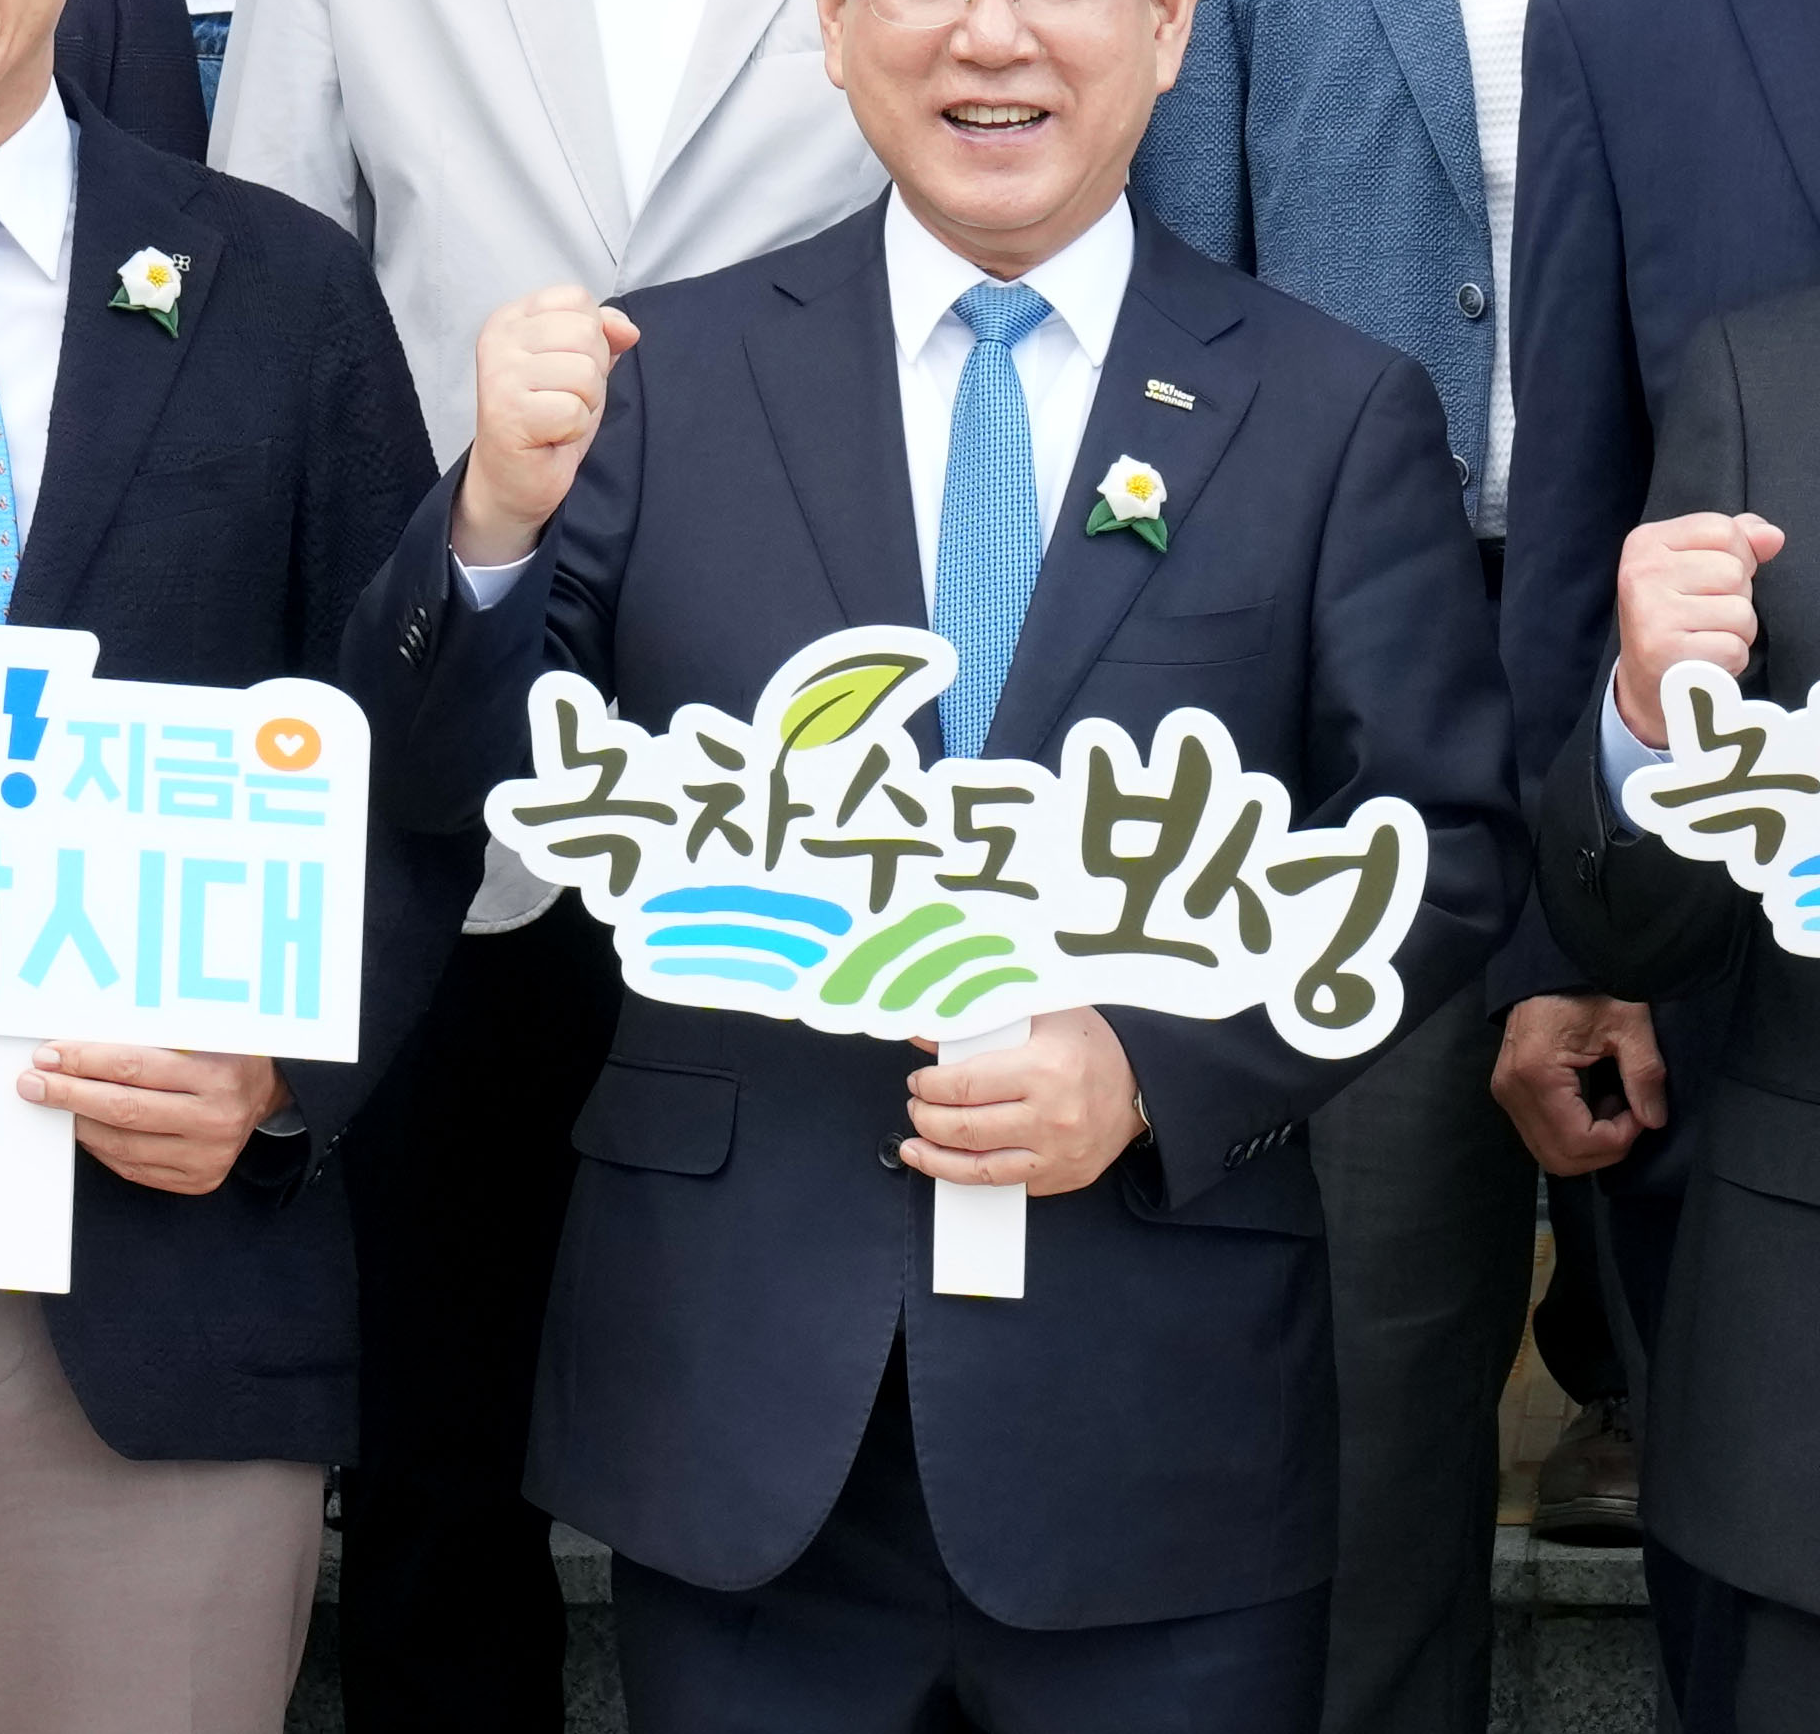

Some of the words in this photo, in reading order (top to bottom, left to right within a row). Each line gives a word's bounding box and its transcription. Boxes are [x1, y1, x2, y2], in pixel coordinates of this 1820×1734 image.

[64, 716, 330, 827] 지금은
[512, 697, 1040, 914] 녹차수도
[1056, 734, 1400, 1030] 보성
